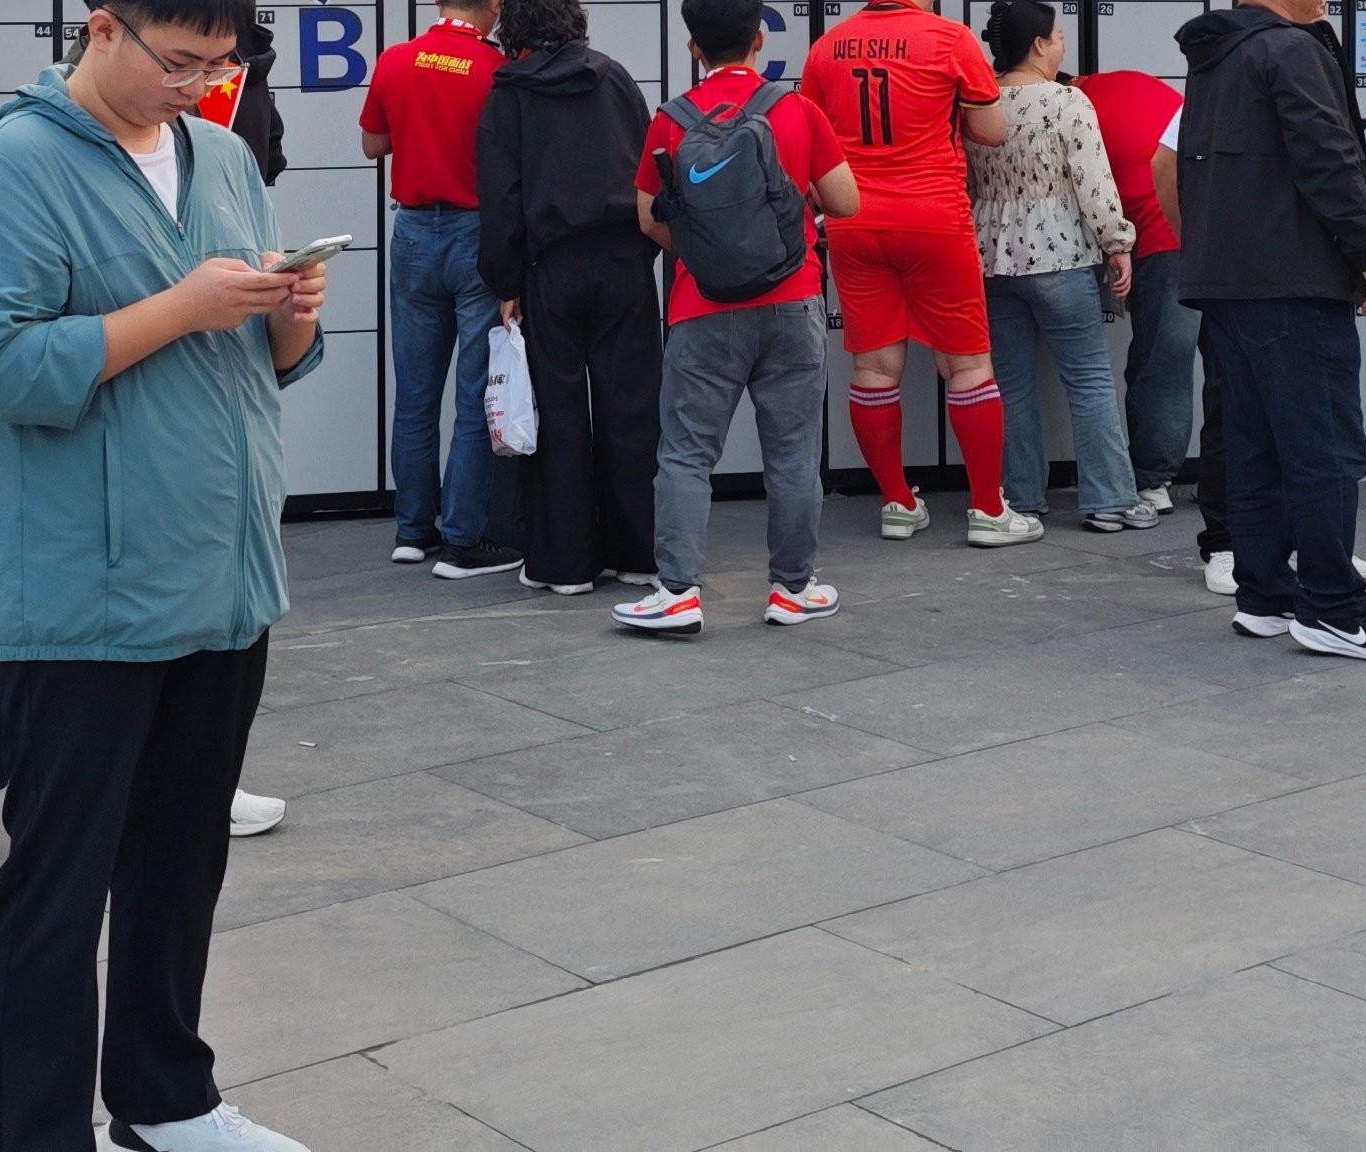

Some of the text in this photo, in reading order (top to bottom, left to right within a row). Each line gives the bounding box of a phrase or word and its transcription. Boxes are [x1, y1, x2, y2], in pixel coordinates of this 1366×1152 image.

[794, 5, 808, 15] 08
[826, 5, 839, 14] 14
[1063, 3, 1077, 13] 20
[1099, 4, 1113, 15] 26
[1329, 5, 1342, 15] 32
[259, 12, 273, 22] 71
[36, 25, 52, 36] 44
[298, 7, 368, 93] B
[833, 38, 863, 60] WEI
[851, 67, 894, 146] 11
